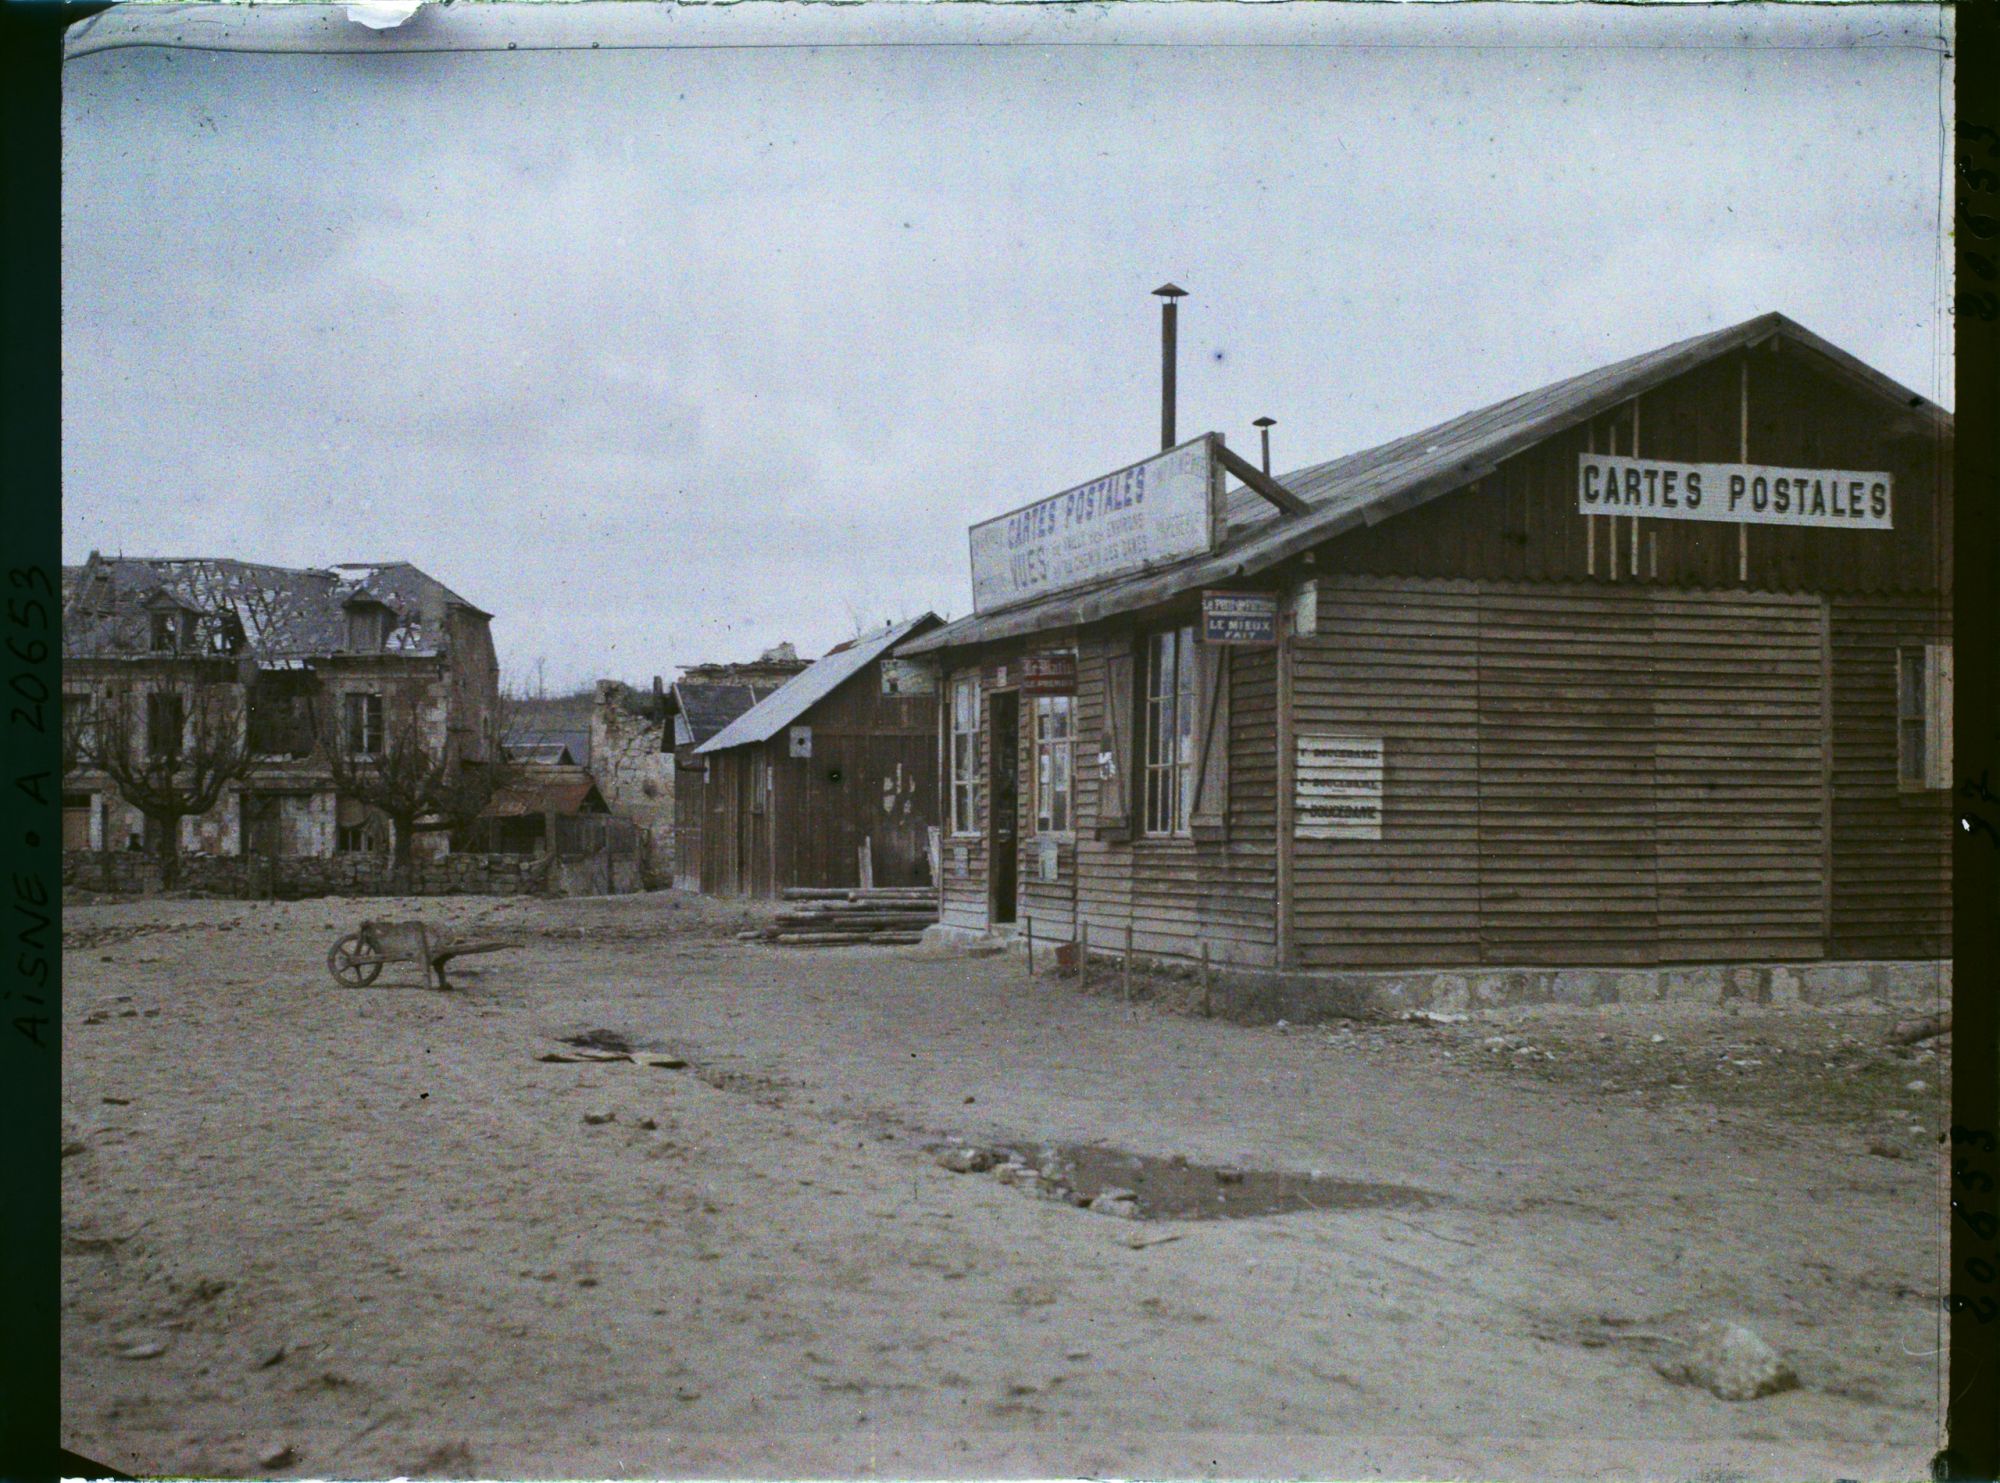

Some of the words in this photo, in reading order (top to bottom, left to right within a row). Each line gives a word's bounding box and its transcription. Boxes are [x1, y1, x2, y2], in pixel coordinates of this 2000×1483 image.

[1008, 500, 1056, 550] CARTES
[1065, 466, 1146, 528] POSTALES
[1584, 464, 1701, 509] CARTES
[1728, 475, 1886, 518] POSTALES
[1209, 620, 1224, 630] LE
[1228, 620, 1271, 632] MIEUX
